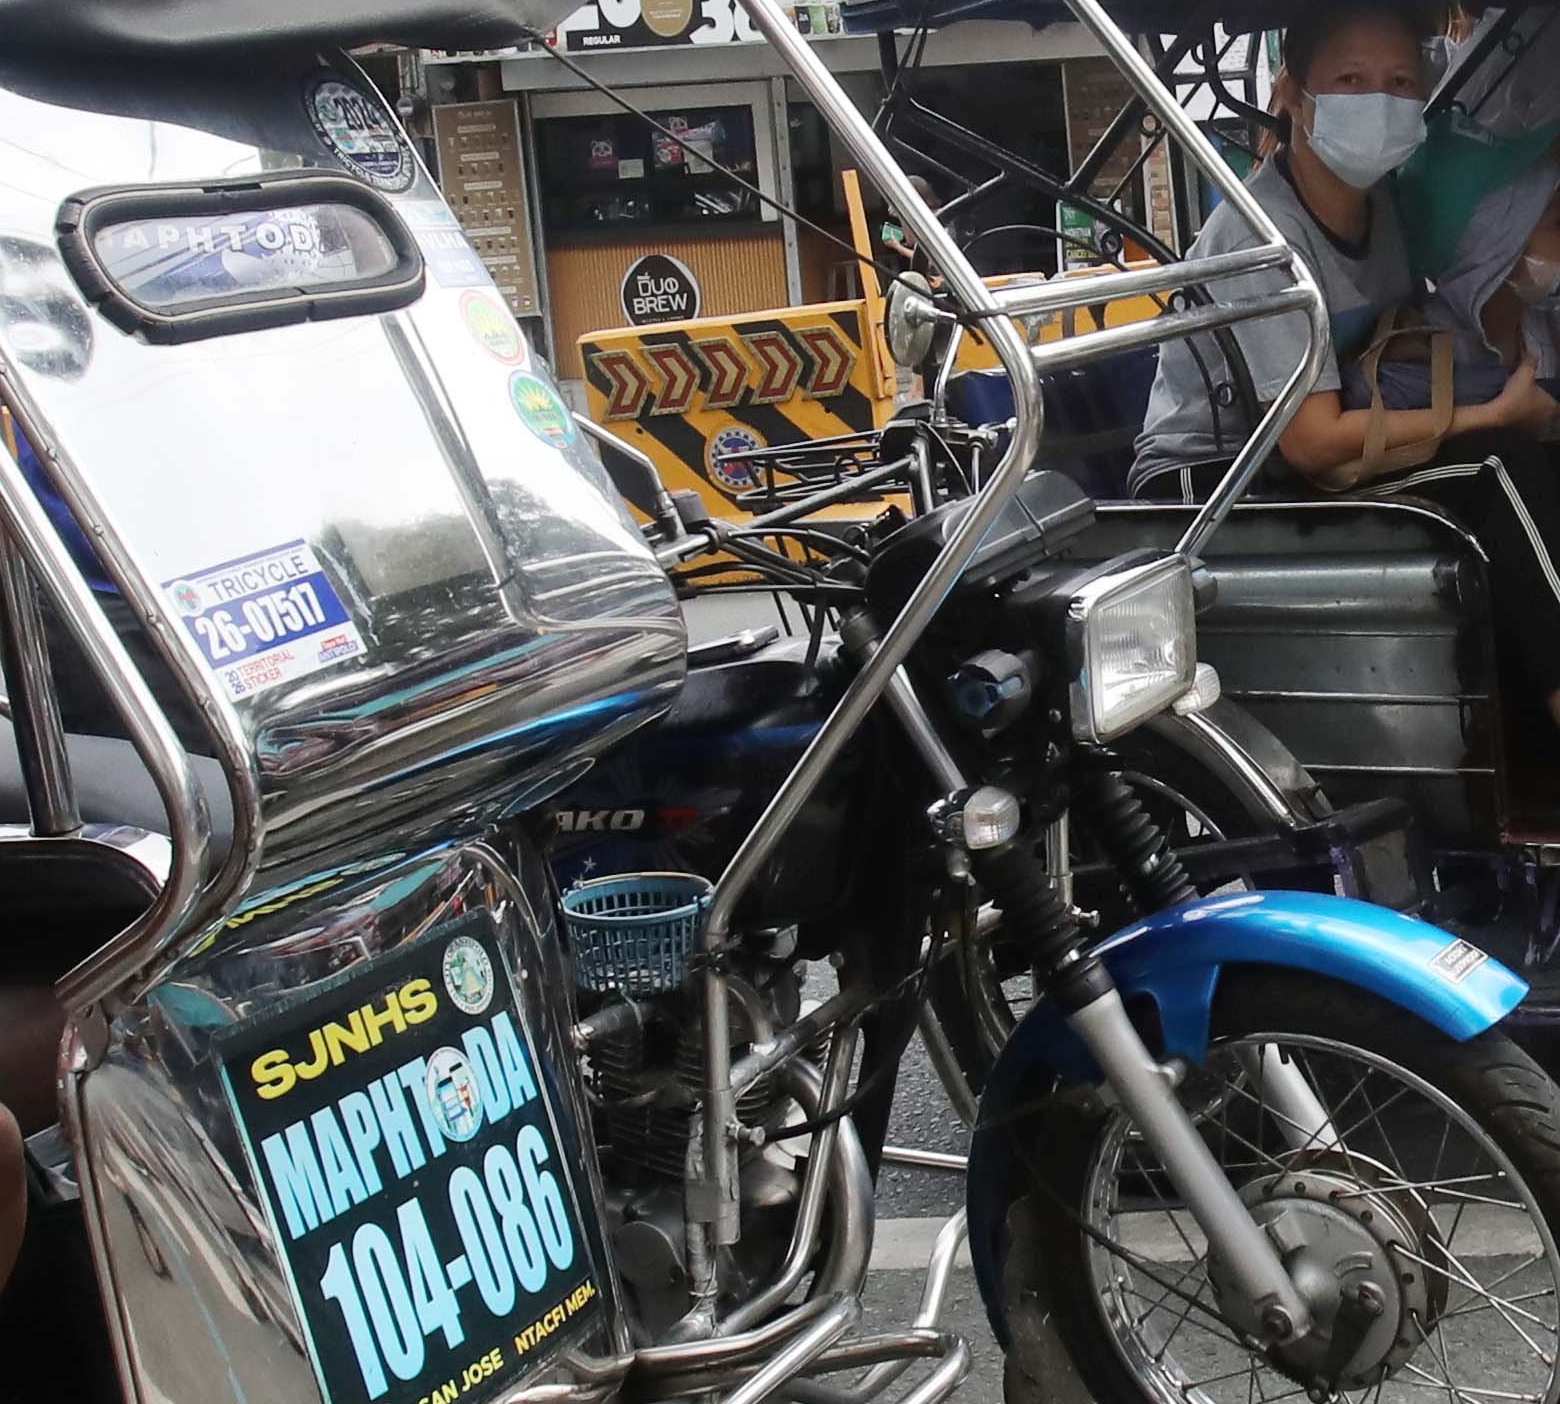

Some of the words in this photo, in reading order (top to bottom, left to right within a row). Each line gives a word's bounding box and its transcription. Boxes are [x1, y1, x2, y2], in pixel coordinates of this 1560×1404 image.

[582, 34, 621, 46] REGULAR
[633, 293, 688, 315] BREW
[637, 274, 680, 297] DUO
[207, 554, 309, 602] TRICYCLE
[194, 581, 327, 661] 26-07517
[244, 667, 282, 690] STICKER
[251, 977, 439, 1101] SJNHS
[320, 1123, 575, 1401] 104-086
[459, 1346, 505, 1392] JOSE
[564, 1280, 597, 1320] MEM.
